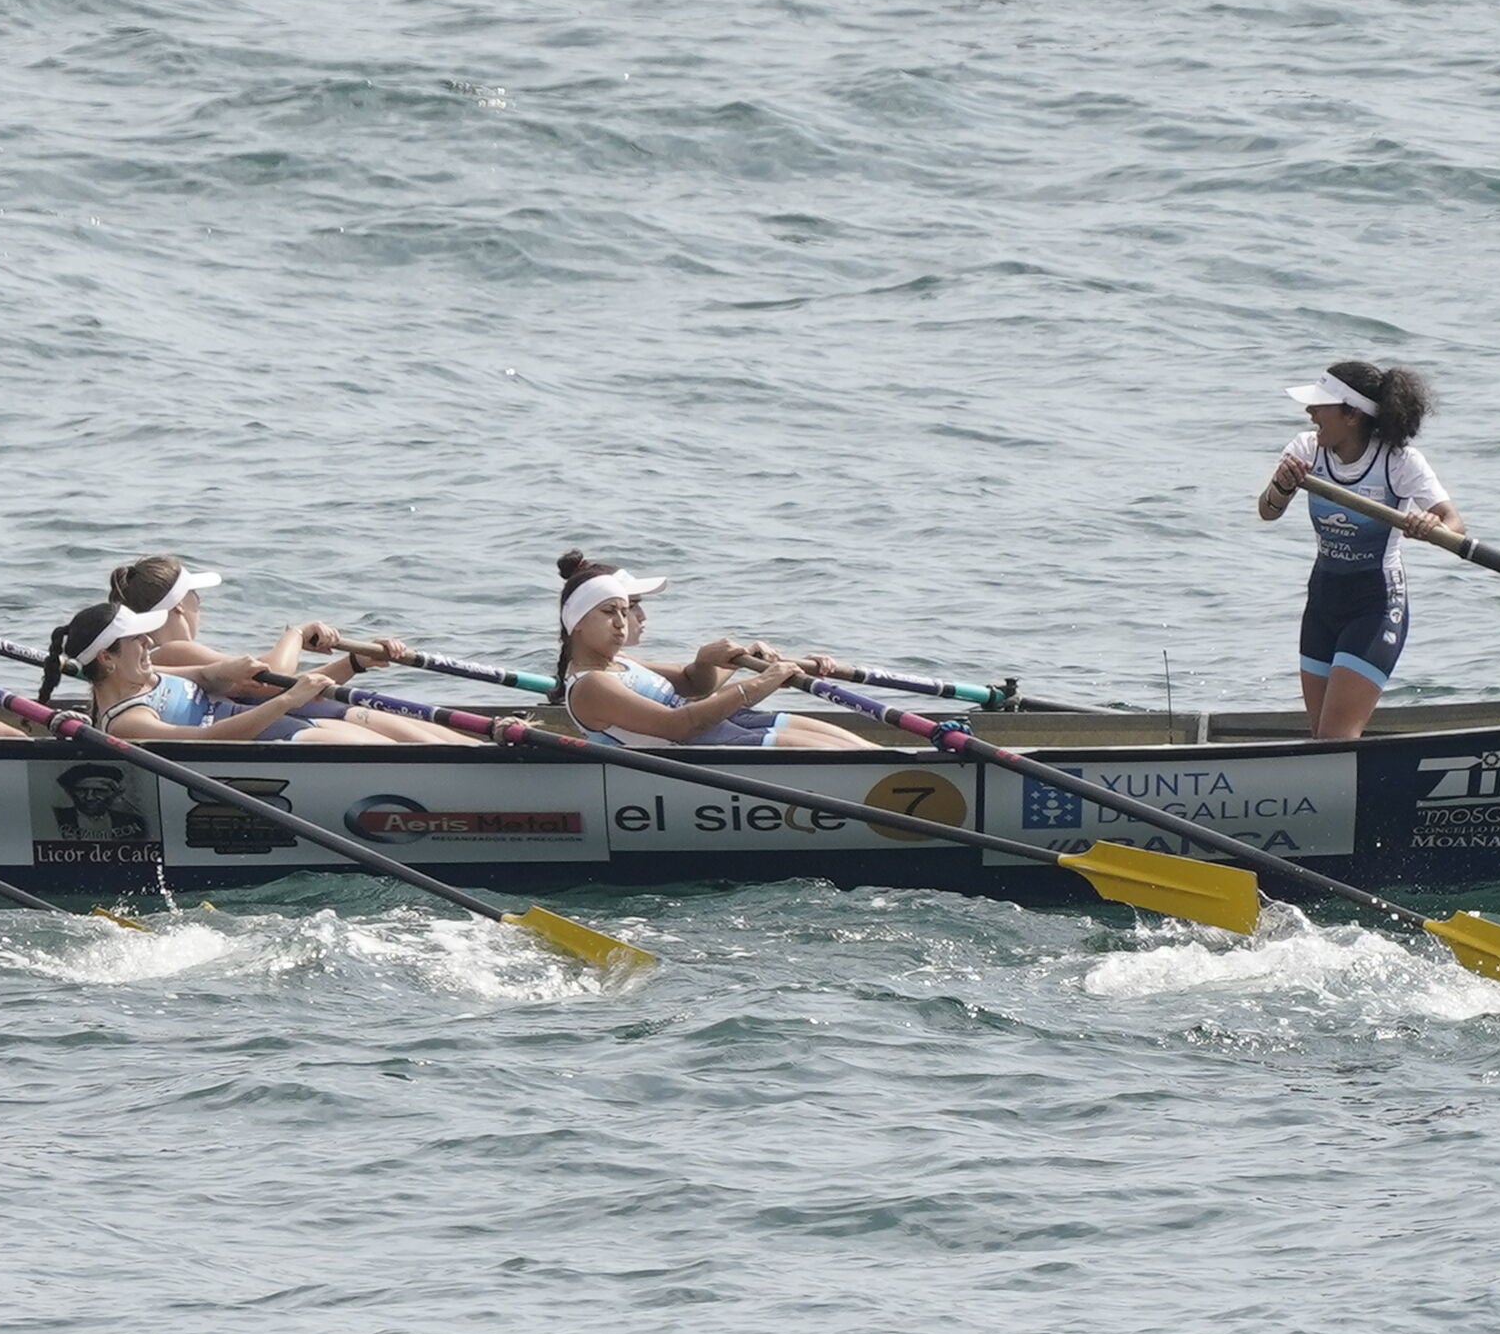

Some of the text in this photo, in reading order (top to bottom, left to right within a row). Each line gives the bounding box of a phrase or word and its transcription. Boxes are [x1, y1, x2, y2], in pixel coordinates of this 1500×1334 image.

[1100, 772, 1234, 799] XUNTA
[615, 795, 666, 831] el
[1160, 797, 1318, 821] GALICIA
[384, 814, 469, 833] Aeris
[37, 843, 162, 864] Licor de Café
